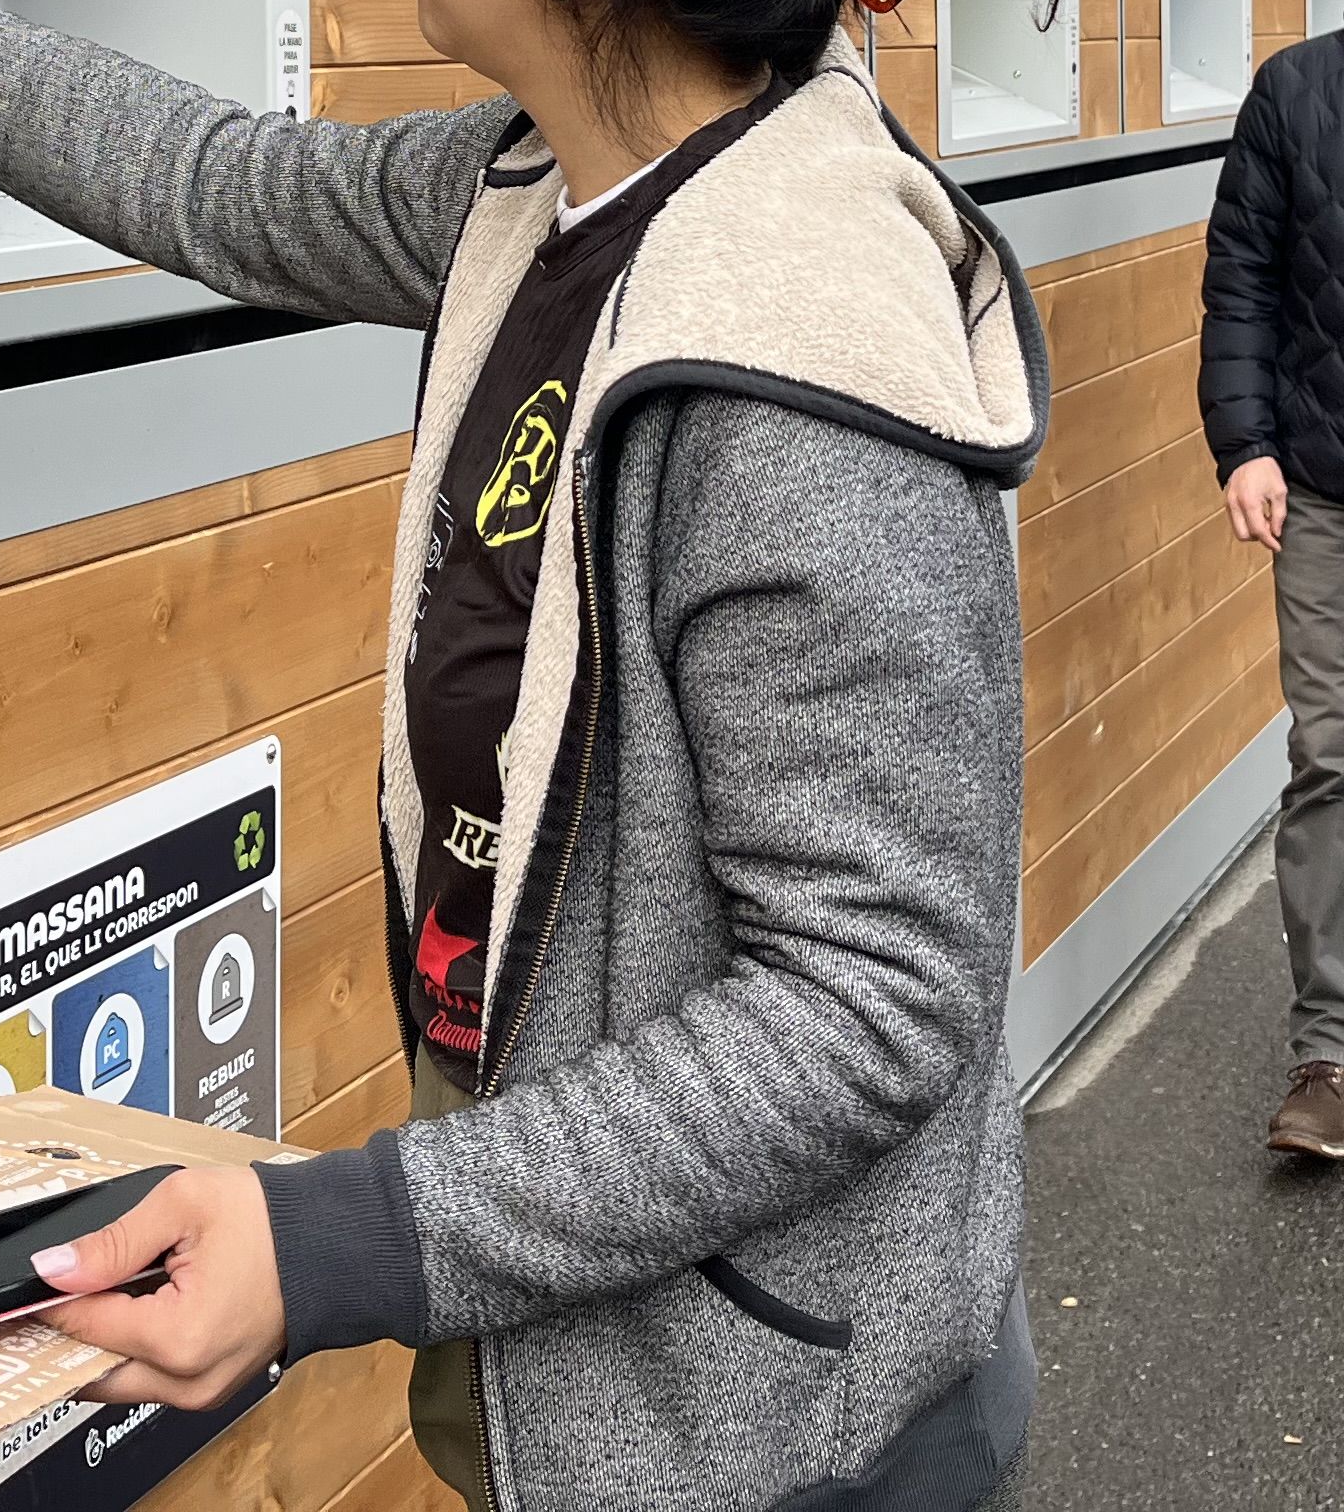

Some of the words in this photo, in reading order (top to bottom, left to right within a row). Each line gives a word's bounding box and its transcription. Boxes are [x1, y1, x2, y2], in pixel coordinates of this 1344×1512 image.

[20, 964, 42, 988] EL
[44, 944, 82, 976] QUE
[84, 932, 102, 956] LI
[105, 880, 199, 944] CORRESPON
[222, 980, 231, 1000] R
[103, 1038, 120, 1064] PC
[198, 1048, 256, 1099] REBUIG
[2, 1436, 22, 1460] be
[26, 1414, 48, 1442] tot
[53, 1398, 70, 1422] es
[106, 1402, 161, 1448] Recicle
